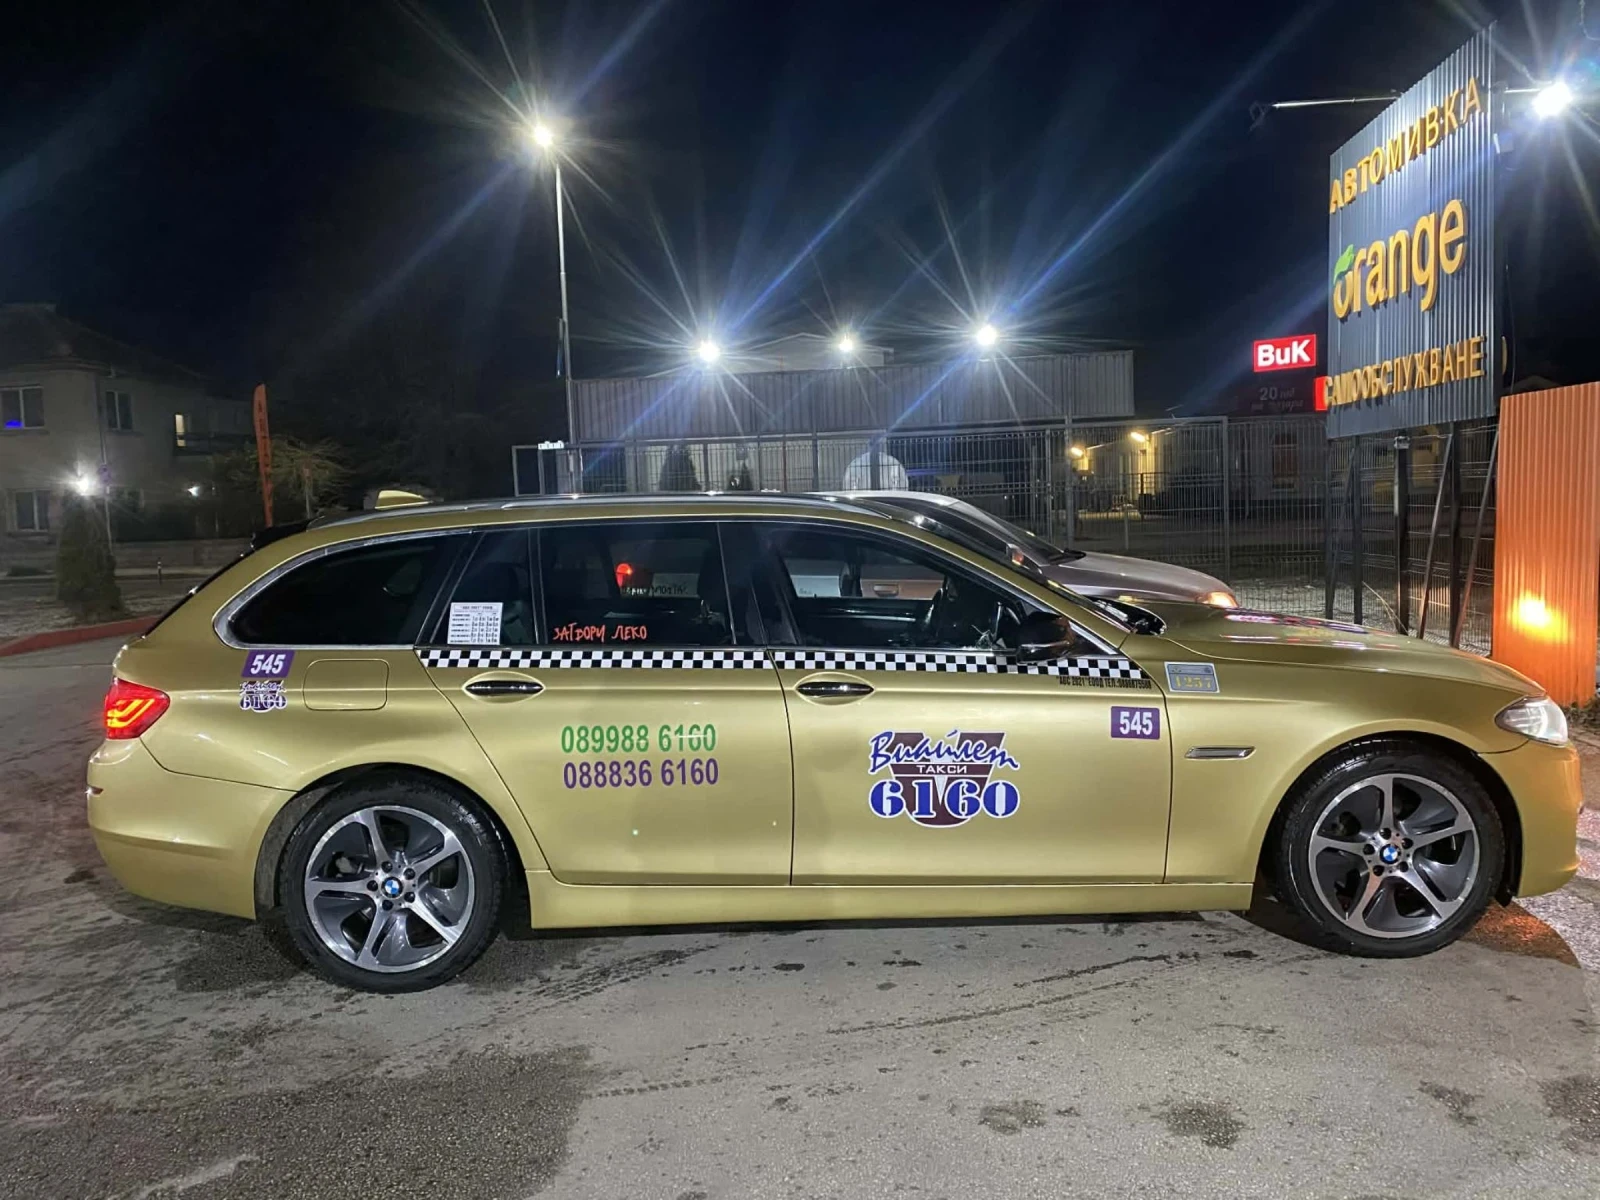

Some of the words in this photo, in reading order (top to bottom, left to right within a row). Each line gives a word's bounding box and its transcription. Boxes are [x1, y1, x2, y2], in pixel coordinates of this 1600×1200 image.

[1329, 76, 1481, 214] АВТОМИВКА
[611, 624, 647, 640] ЛЕКО
[250, 654, 286, 674] 545
[1119, 711, 1152, 735] 545
[561, 724, 649, 753] 089988
[658, 724, 716, 752] 6160
[563, 760, 652, 789] 088836
[661, 758, 718, 786] 6160
[916, 765, 967, 774] ТАКСИ
[870, 780, 1019, 818] 6160
